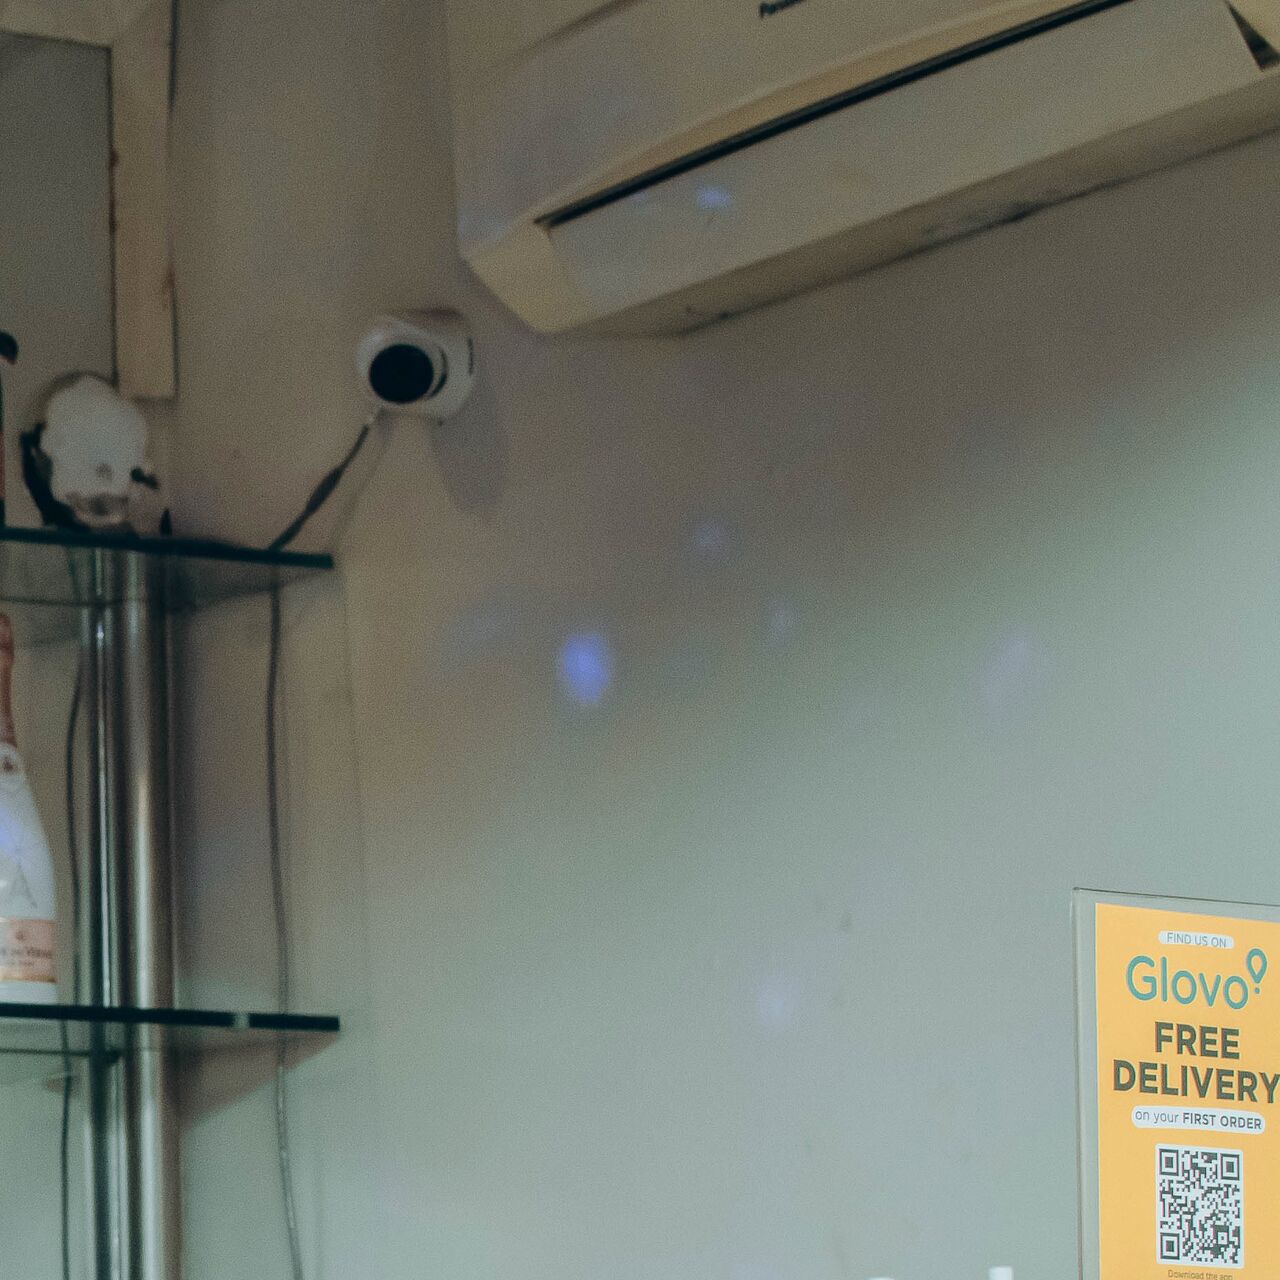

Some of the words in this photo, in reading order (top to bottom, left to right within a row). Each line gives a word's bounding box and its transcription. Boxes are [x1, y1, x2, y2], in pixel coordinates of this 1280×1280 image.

[1167, 932, 1191, 945] FIND
[1195, 934, 1208, 947] US
[1211, 936, 1227, 948] ON
[1154, 1021, 1240, 1060] FREE
[1113, 1059, 1280, 1104] DELIVERY
[1135, 1110, 1150, 1121] on
[1153, 1112, 1179, 1124] your
[1182, 1112, 1217, 1126] FIRST
[1220, 1115, 1262, 1130] ORDER
[1168, 1269, 1205, 1280] Download
